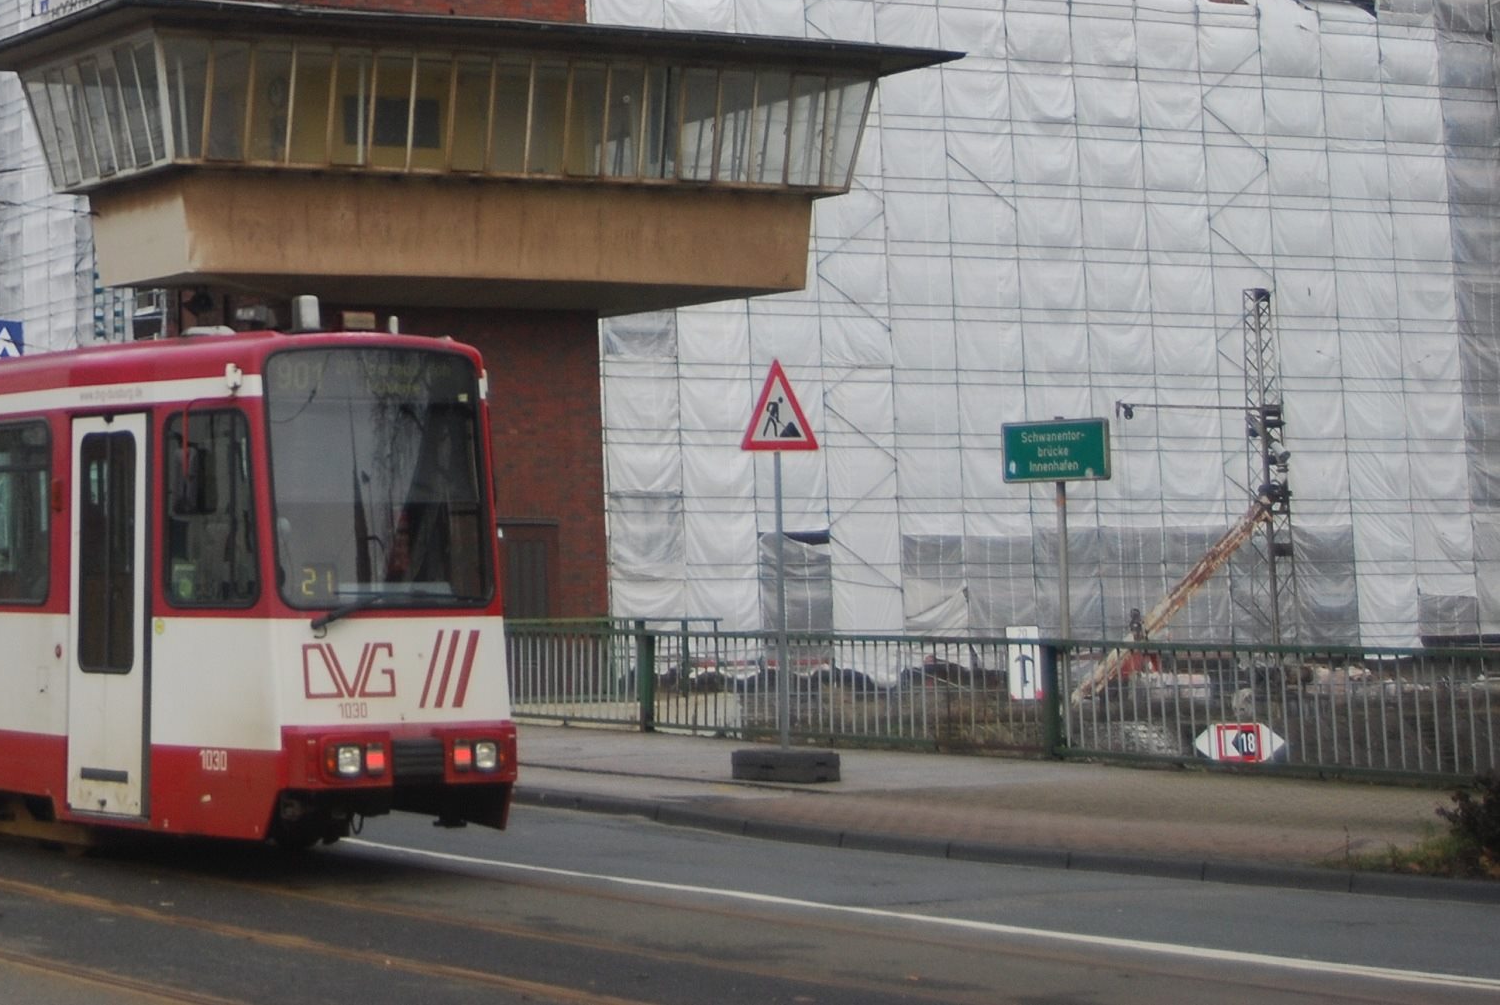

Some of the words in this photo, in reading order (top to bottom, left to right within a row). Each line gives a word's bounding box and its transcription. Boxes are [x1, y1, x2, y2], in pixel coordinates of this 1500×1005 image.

[1020, 430, 1085, 444] Schwanentor-
[1037, 445, 1069, 458] brücke
[1029, 459, 1079, 473] Innenhafen
[301, 568, 334, 595] 21
[302, 642, 397, 699] DVG
[338, 702, 368, 718] 1030
[1240, 732, 1256, 753] 18
[200, 750, 228, 771] 1030
